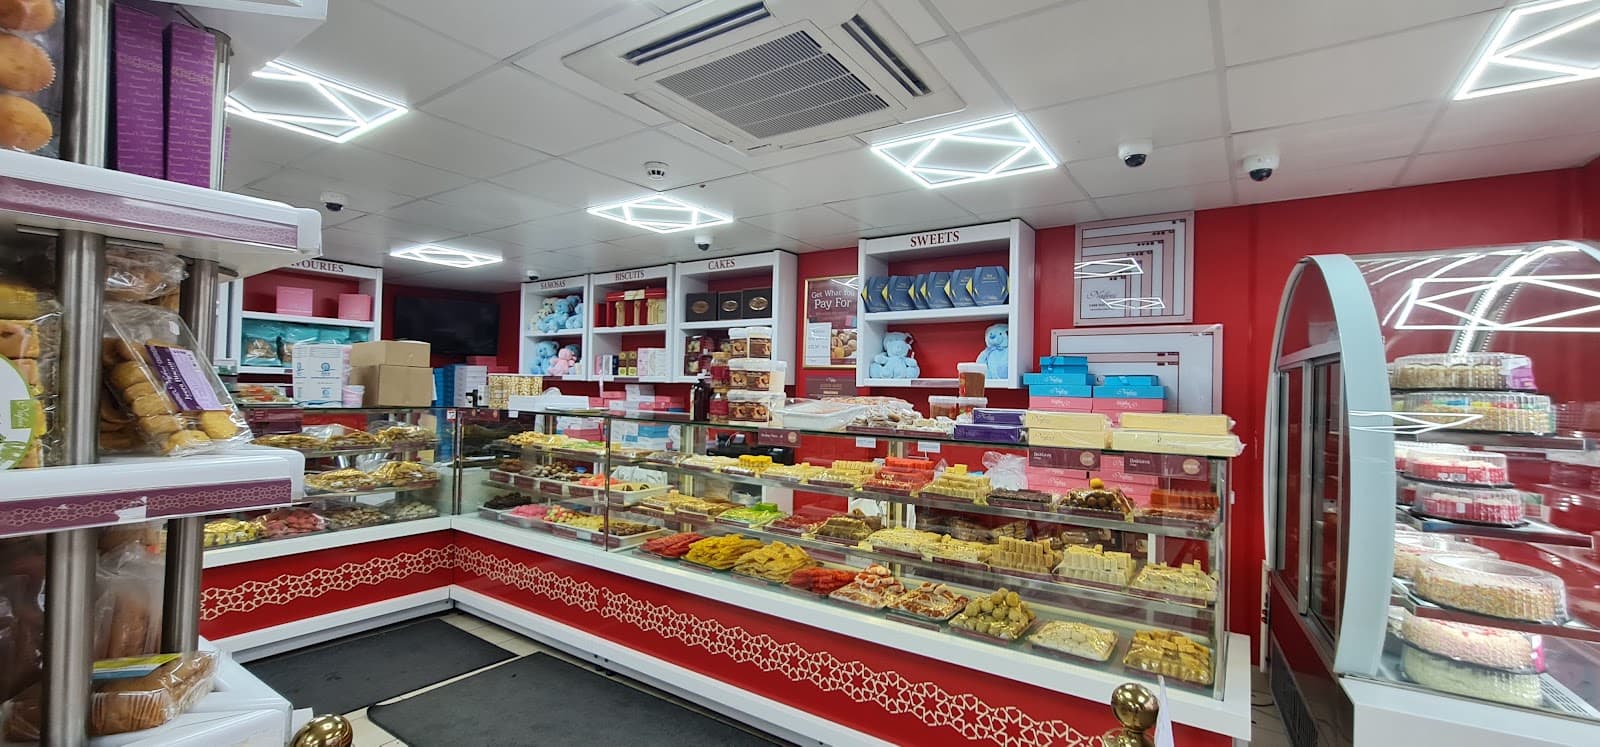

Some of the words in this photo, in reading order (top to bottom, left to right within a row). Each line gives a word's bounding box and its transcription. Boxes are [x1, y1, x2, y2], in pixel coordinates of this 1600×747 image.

[910, 230, 960, 248] SWEETS
[707, 258, 736, 270] CAKES
[615, 270, 645, 281] BISCUITS
[540, 280, 567, 290] SAMOSAS
[824, 289, 841, 297] What
[814, 299, 832, 310] Pay
[835, 297, 852, 308] For
